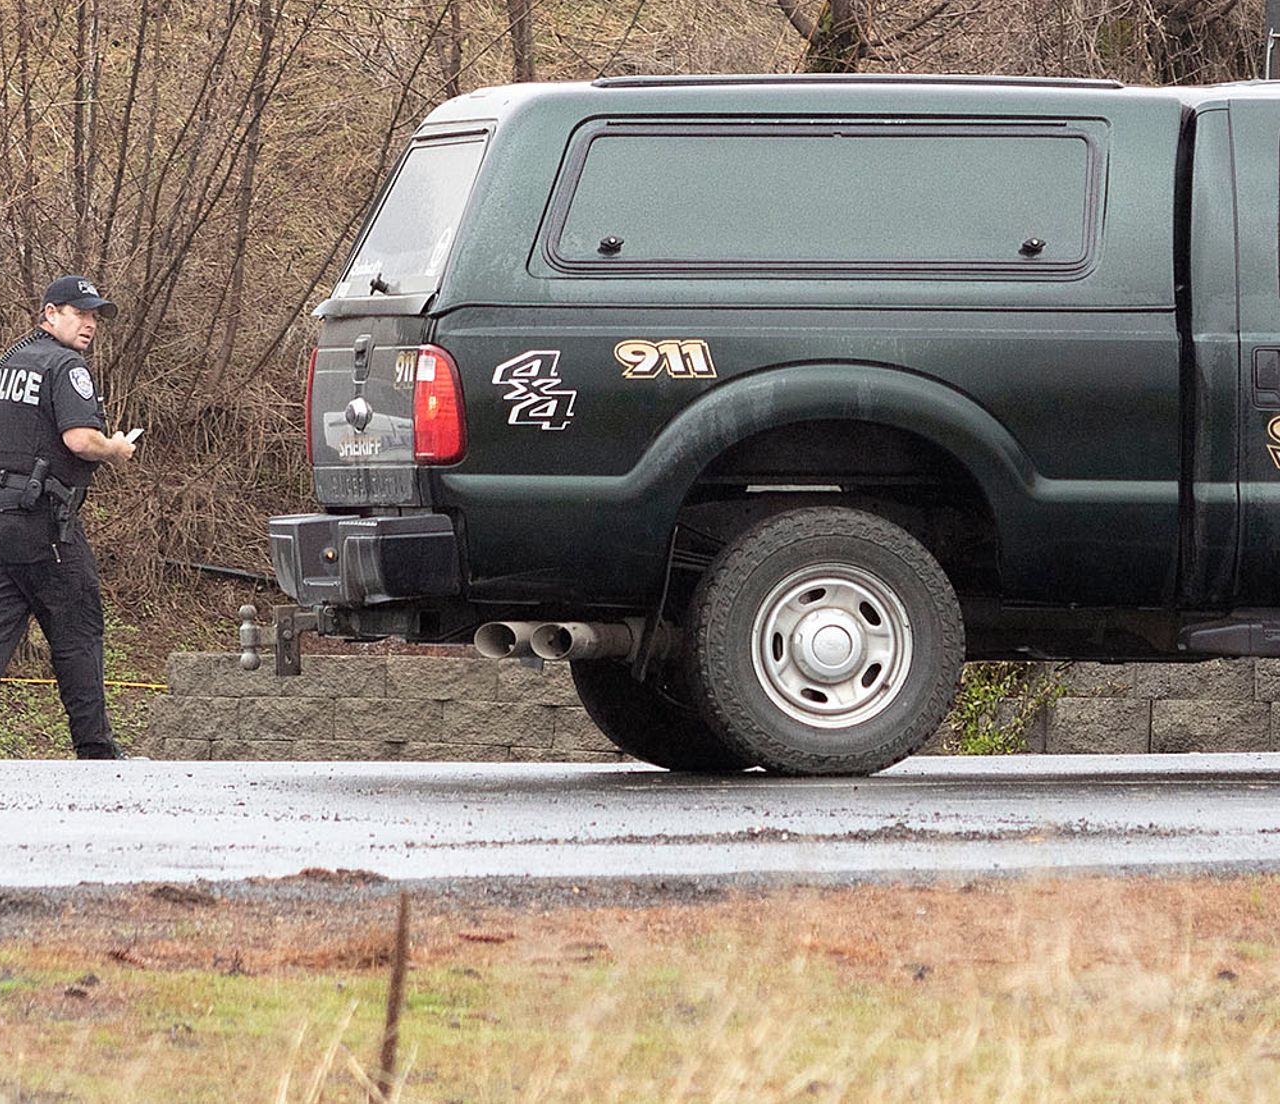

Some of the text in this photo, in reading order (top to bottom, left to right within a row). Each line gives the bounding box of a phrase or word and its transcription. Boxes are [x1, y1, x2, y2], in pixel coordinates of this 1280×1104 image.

[393, 351, 417, 387] 911
[614, 339, 717, 379] 911
[338, 433, 382, 457] SHERIFF
